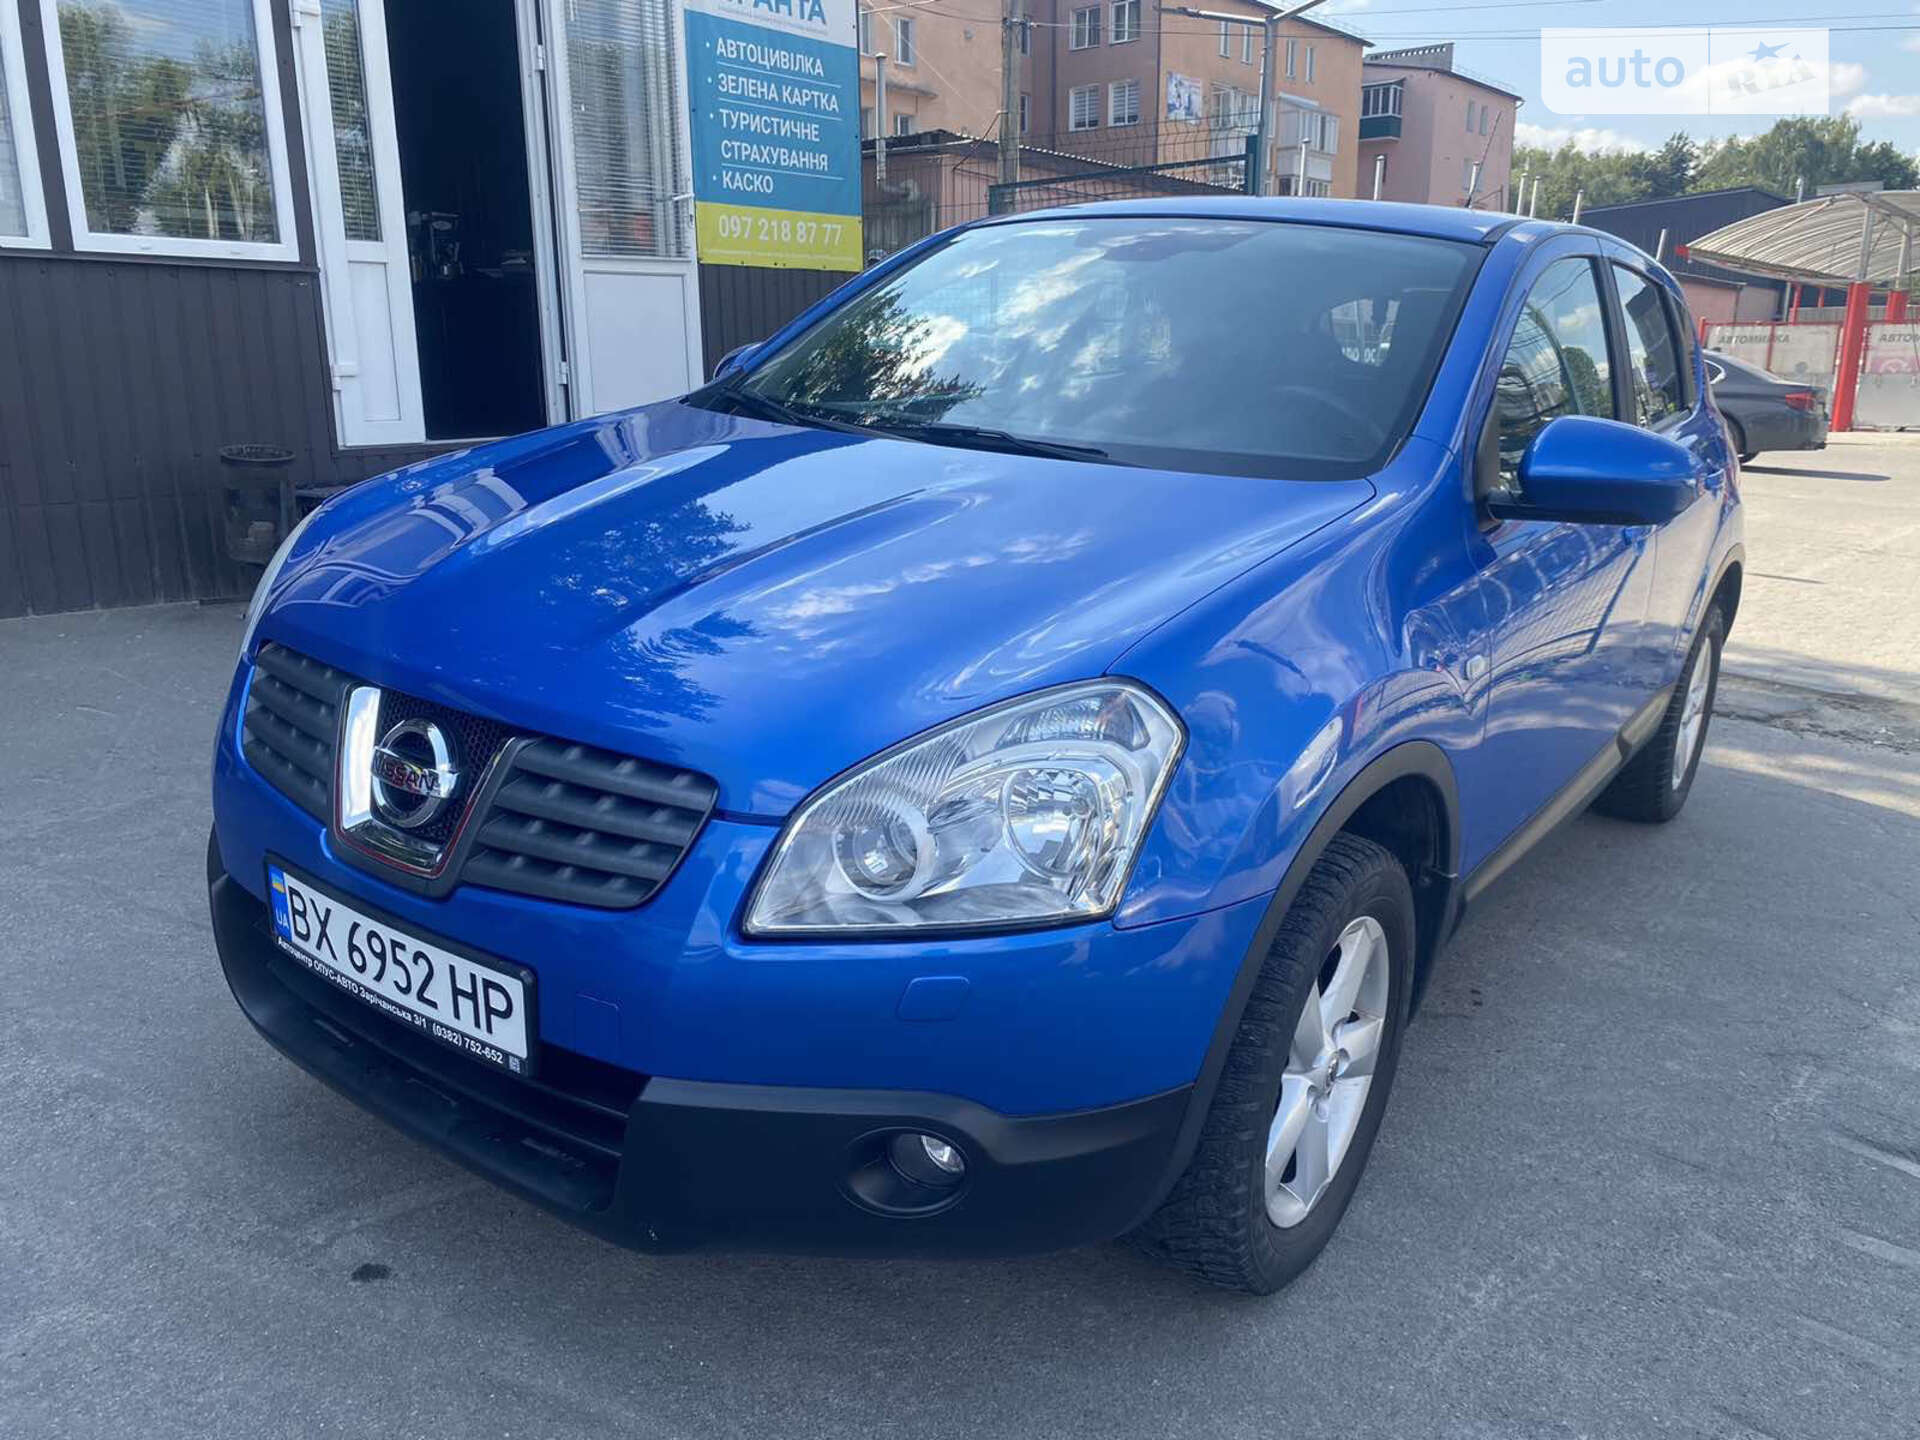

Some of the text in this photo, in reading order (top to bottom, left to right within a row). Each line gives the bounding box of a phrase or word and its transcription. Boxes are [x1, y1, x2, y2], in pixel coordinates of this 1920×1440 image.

[716, 38, 825, 77] АВТОЦИВІЛКА
[718, 73, 840, 113] ЗЕЛЕНА КАРТКА
[719, 108, 820, 142] ТУРИСТИЧНЕ
[721, 139, 829, 171] СТРАХУВАННЯ
[722, 171, 774, 194] КАСКО
[718, 214, 842, 247] 097 218 87 77
[275, 908, 290, 929] UA
[288, 885, 513, 1035] BX 6952 HP
[313, 959, 359, 994] ОПУС-АВТО
[432, 1023, 462, 1047] (0382)
[464, 1037, 504, 1064] 752-652
